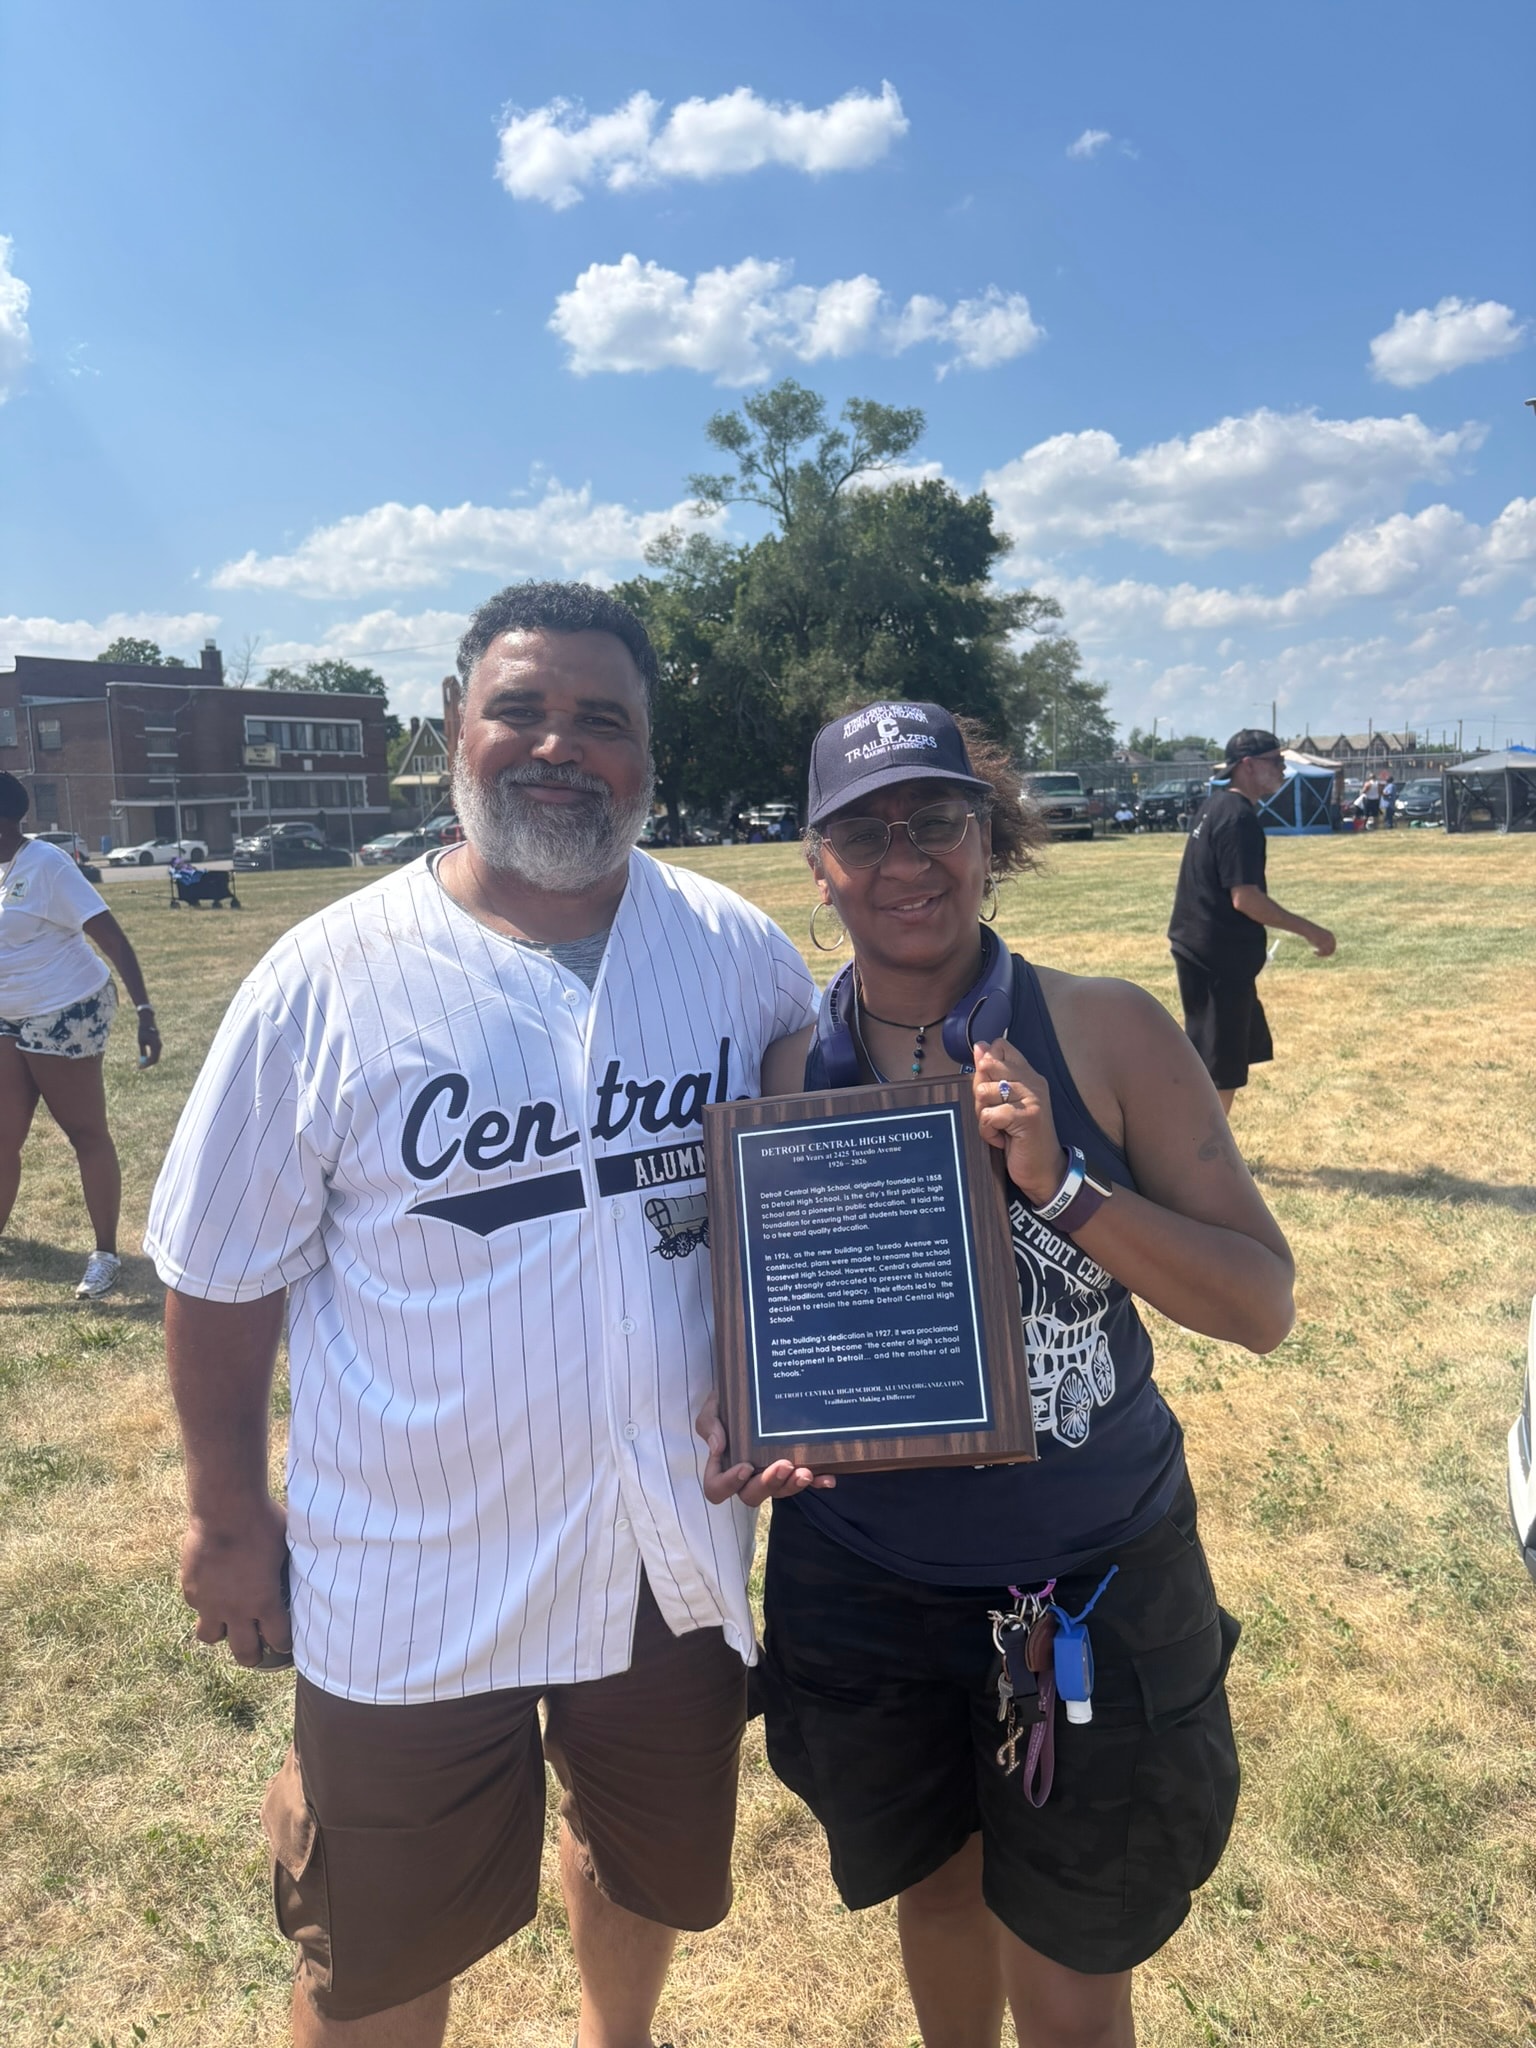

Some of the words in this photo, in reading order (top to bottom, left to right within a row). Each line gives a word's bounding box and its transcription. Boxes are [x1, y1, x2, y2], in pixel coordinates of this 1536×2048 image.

[877, 719, 900, 738] C
[845, 733, 937, 763] TRAILBLAZERS
[761, 1144, 807, 1157] DETROIT
[808, 1138, 857, 1152] CENTRAL
[859, 1135, 886, 1146] HIGH
[888, 1130, 933, 1143] SCHOOL
[793, 1155, 805, 1163] 100
[806, 1153, 824, 1161] Years
[834, 1150, 850, 1159] 2425
[852, 1147, 876, 1156] Tuxedo
[876, 1145, 902, 1154] Avenue
[634, 1145, 706, 1188] ALUMN
[828, 1160, 844, 1168] 1926
[851, 1157, 868, 1166] 2026
[760, 1191, 782, 1199] Detroit
[784, 1188, 809, 1197] Central
[810, 1186, 826, 1195] High
[853, 1180, 885, 1191] originally
[886, 1176, 916, 1186] founded
[926, 1174, 943, 1182] 1858
[771, 1199, 795, 1208] Detroit
[797, 1198, 814, 1207] High
[851, 1192, 864, 1200] the
[886, 1188, 900, 1196] first
[901, 1186, 925, 1196] public
[927, 1185, 944, 1194] high
[761, 1211, 785, 1220] school
[786, 1209, 800, 1217] and
[808, 1206, 835, 1215] pioneer
[844, 1202, 866, 1212] public
[917, 1196, 931, 1204] laid
[762, 1220, 800, 1230] foundation
[800, 1218, 810, 1226] for
[812, 1216, 842, 1226] ensuring
[843, 1214, 857, 1222] that
[869, 1210, 898, 1219] students
[899, 1208, 918, 1216] have
[919, 1206, 946, 1214] access
[777, 1231, 791, 1239] free
[792, 1229, 807, 1237] and
[808, 1227, 831, 1237] quality
[1009, 1200, 1077, 1267] DETROIT
[810, 1259, 830, 1268] plans
[850, 1255, 872, 1264] made
[873, 1254, 881, 1262] to
[882, 1253, 911, 1261] rename
[912, 1250, 924, 1258] the
[925, 1248, 951, 1257] school
[834, 1245, 863, 1256] building
[876, 1241, 902, 1251] Tuxedo
[904, 1239, 932, 1248] Avenue
[766, 1272, 799, 1282] Roosevelt
[801, 1271, 817, 1280] High
[911, 1260, 936, 1269] alumni
[937, 1259, 952, 1267] and
[766, 1283, 793, 1293] faculty
[794, 1281, 824, 1291] strongly
[825, 1277, 868, 1287] advocated
[879, 1274, 912, 1283] preserve
[925, 1269, 953, 1279] historic
[873, 1285, 891, 1293] Their
[891, 1283, 914, 1292] efforts
[915, 1282, 928, 1290] led
[941, 1280, 954, 1288] the
[768, 1304, 801, 1314] decision
[803, 1303, 811, 1311] to
[813, 1301, 836, 1310] retain
[876, 1295, 903, 1304] Detroit
[905, 1292, 935, 1302] Central
[936, 1291, 955, 1301] High
[827, 1331, 865, 1342] dedication
[916, 1324, 959, 1335] proclaimed
[771, 1349, 786, 1357] that
[787, 1347, 814, 1356] Central
[815, 1345, 830, 1353] had
[831, 1343, 862, 1352] become
[881, 1340, 905, 1348] center
[907, 1338, 915, 1346] of
[916, 1337, 933, 1347] high
[934, 1335, 960, 1344] school
[772, 1357, 825, 1368] development
[874, 1352, 890, 1360] and
[907, 1348, 937, 1357] mother
[939, 1347, 948, 1355] of
[949, 1346, 961, 1354] all
[805, 1389, 835, 1397] CENTRAL
[911, 1380, 965, 1390] ORGANIZATION
[824, 1397, 857, 1405] Trailblazers
[859, 1395, 881, 1404] Making
[886, 1393, 916, 1401] Difference
